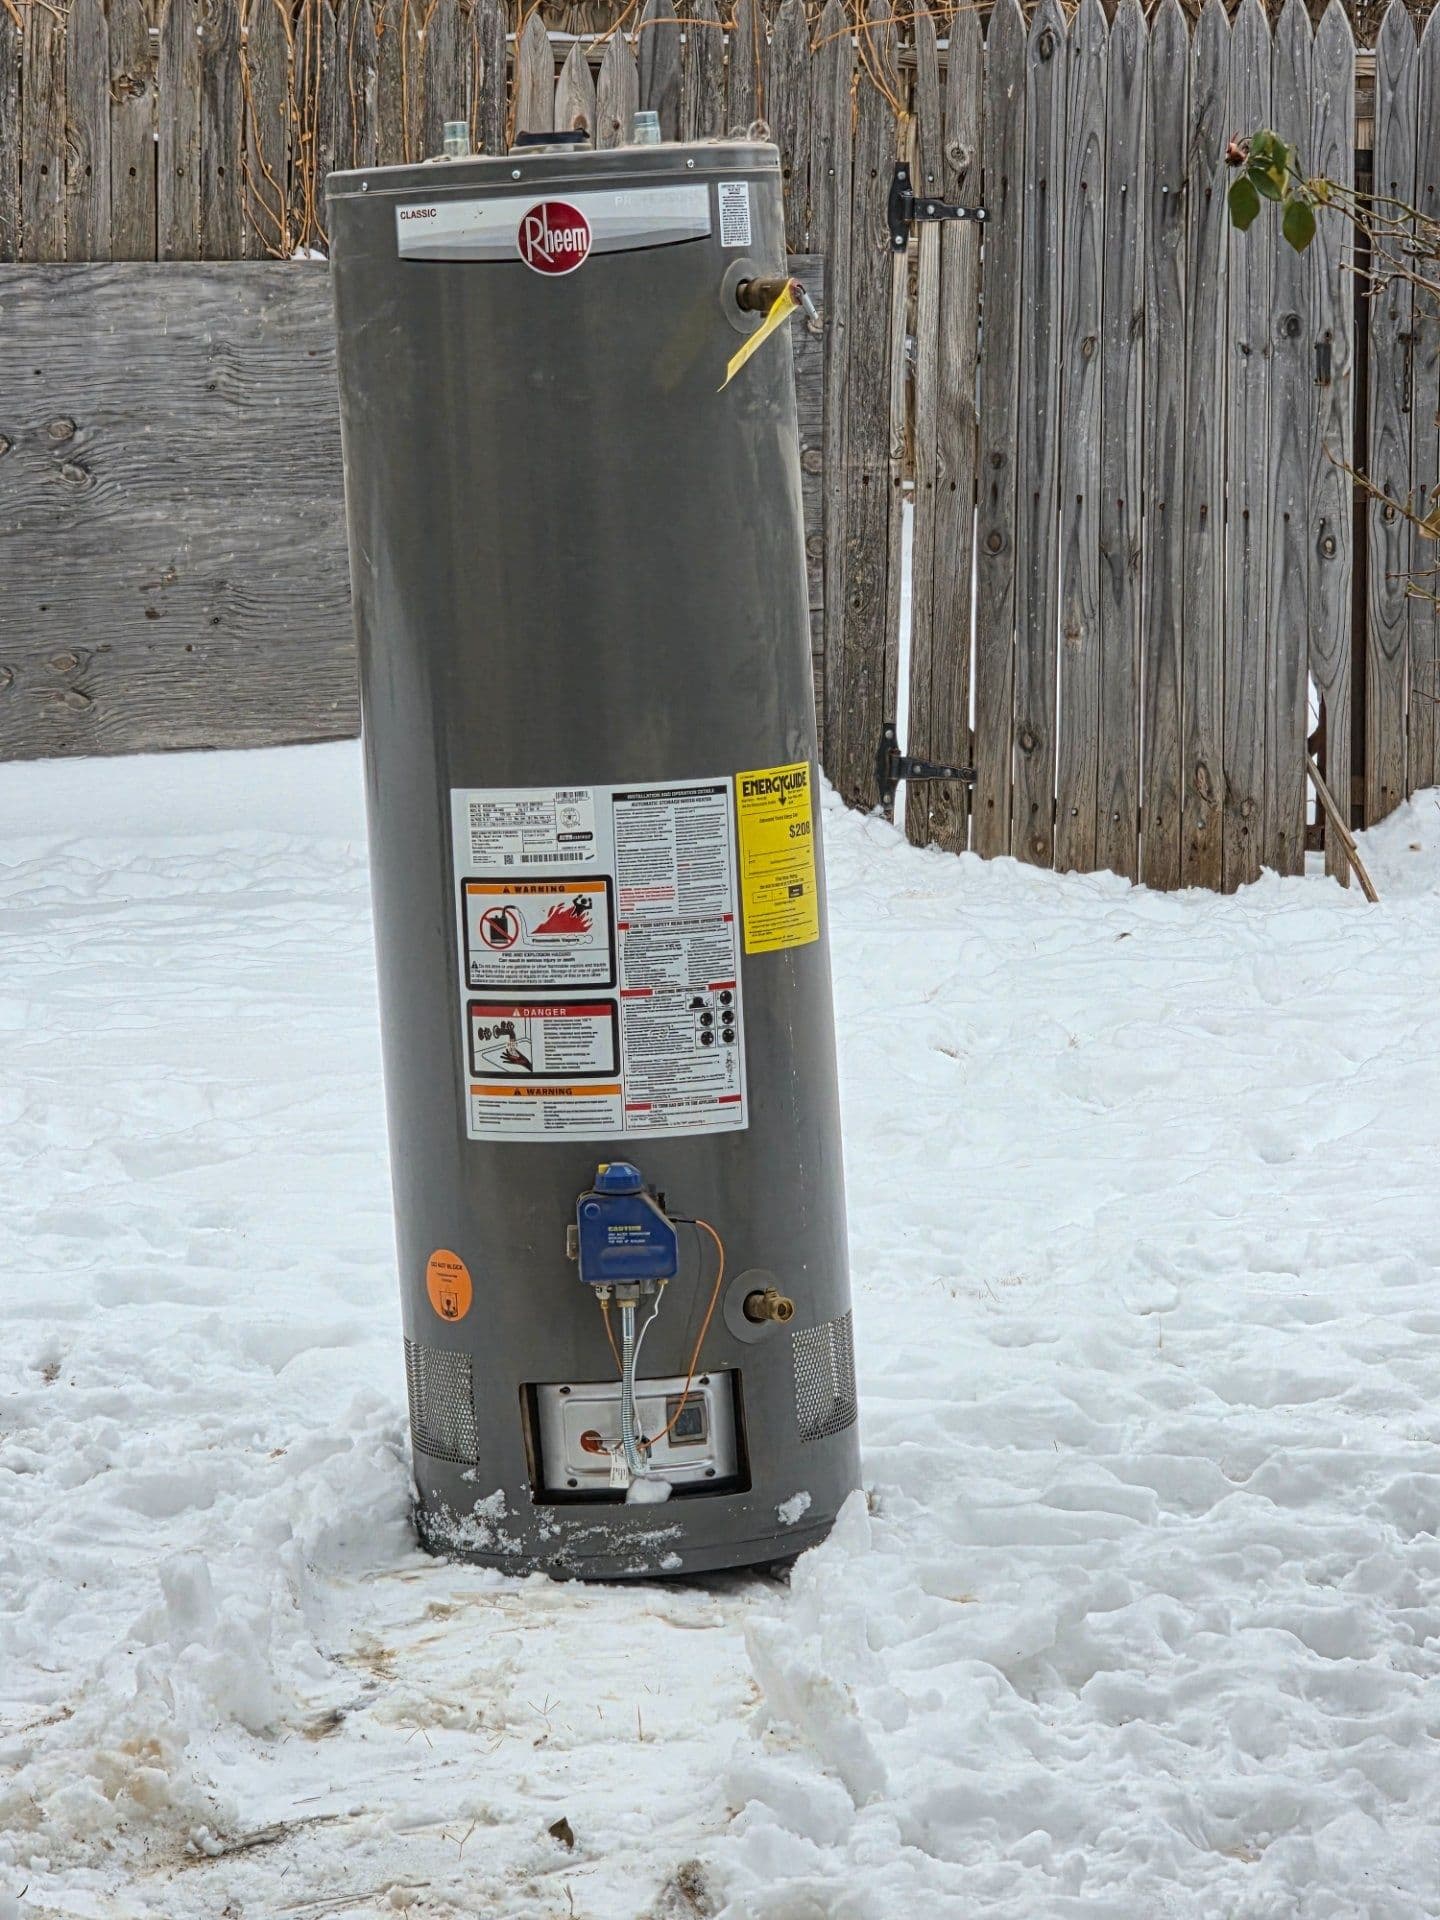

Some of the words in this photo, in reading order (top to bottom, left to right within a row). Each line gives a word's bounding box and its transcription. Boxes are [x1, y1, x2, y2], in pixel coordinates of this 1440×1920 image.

[400, 208, 437, 220] CLASSIC
[525, 203, 588, 263] Rheem
[742, 771, 807, 797] ENERGYGUIDE
[514, 885, 566, 894] WARNING
[523, 1008, 567, 1016] DANGER
[526, 1088, 573, 1096] WARNING
